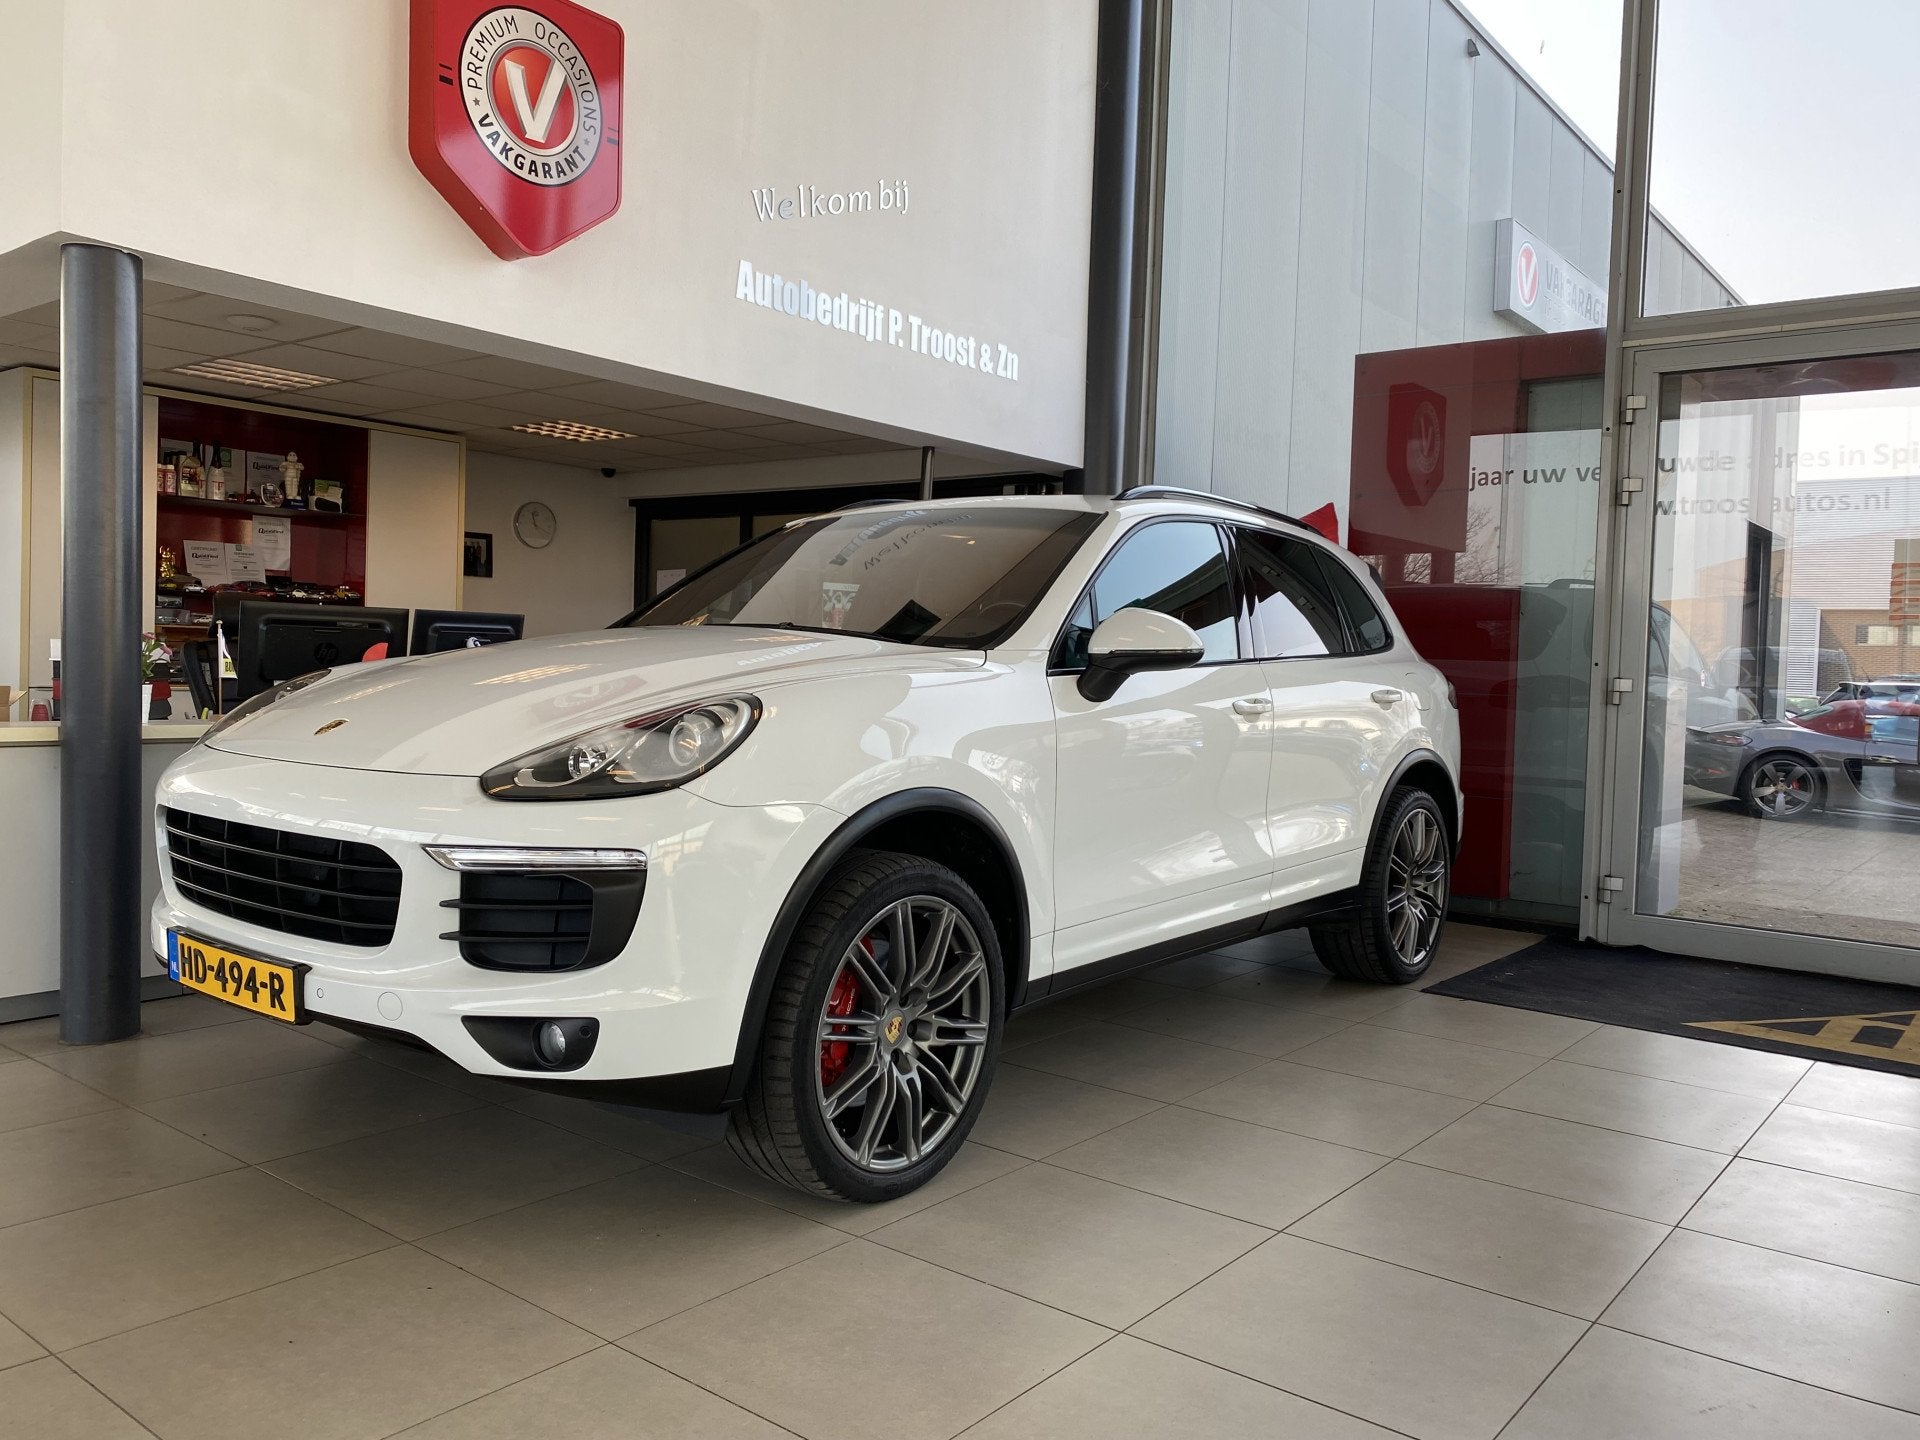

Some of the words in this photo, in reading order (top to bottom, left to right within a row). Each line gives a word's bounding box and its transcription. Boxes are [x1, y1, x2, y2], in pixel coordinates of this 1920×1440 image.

[467, 15, 519, 91] PREMIUM
[534, 21, 598, 136] OCCASIONS
[477, 112, 587, 180] VAKGARANT
[751, 184, 872, 222] Welkom
[878, 179, 909, 215] bij
[735, 259, 884, 342] Autobedrijf
[888, 308, 904, 348] P.
[908, 314, 976, 369] Troost
[979, 343, 993, 373] &
[997, 343, 1019, 381] Zn
[1469, 466, 1514, 491] jaar
[1523, 467, 1567, 484] uw
[1747, 447, 1832, 470] dres
[1839, 445, 1866, 467] in
[1873, 440, 1920, 470] Spi
[179, 942, 287, 1012] HD-494-R
